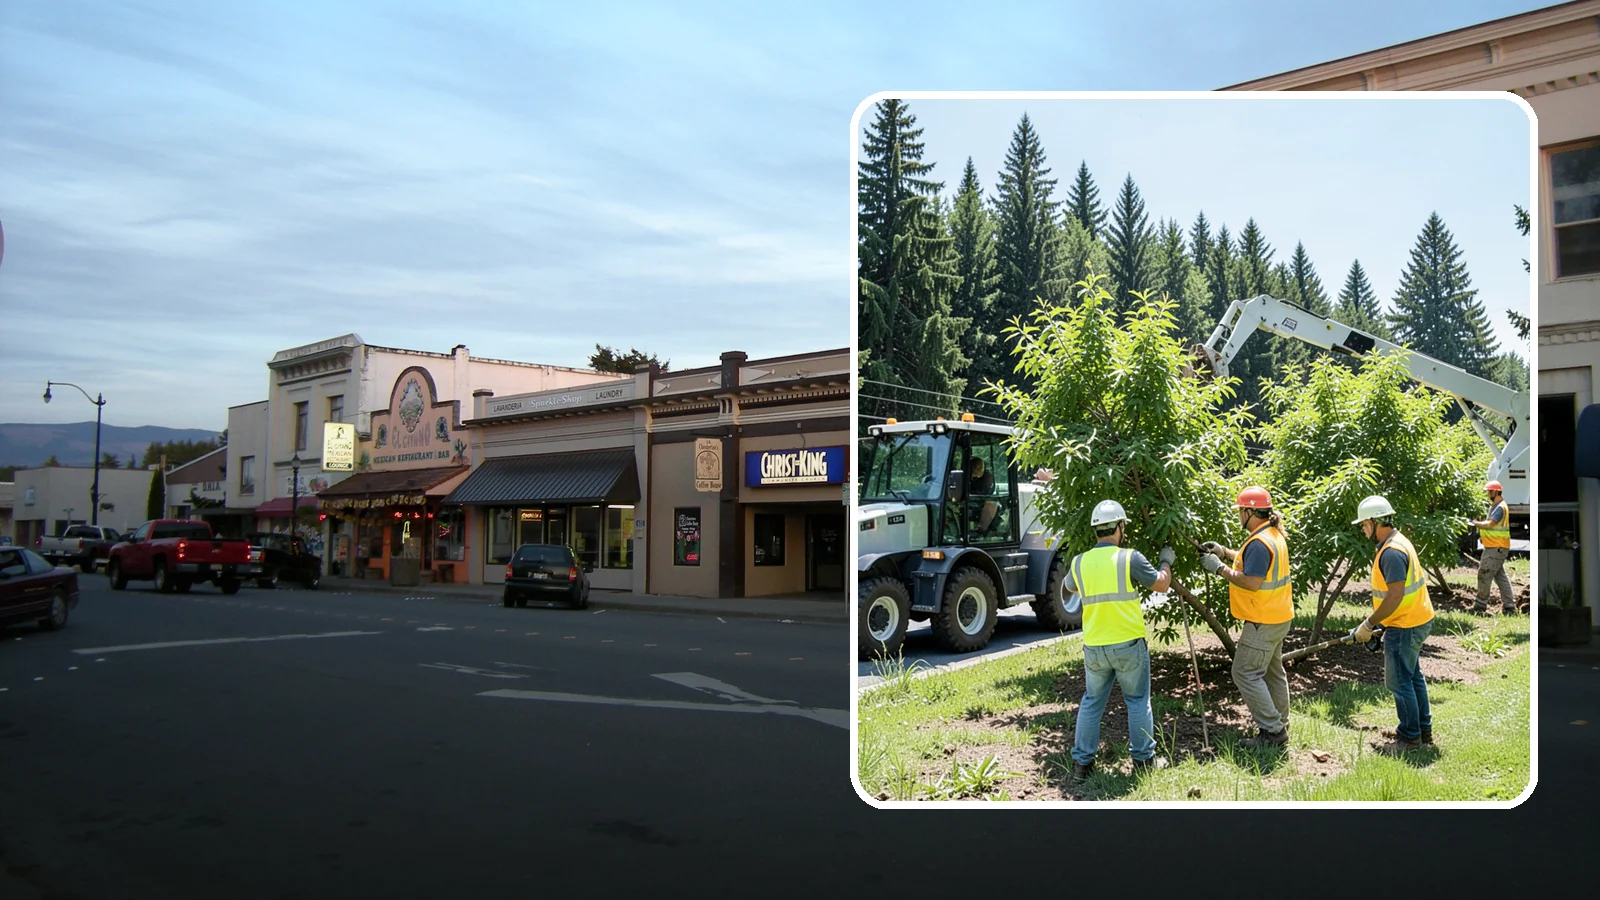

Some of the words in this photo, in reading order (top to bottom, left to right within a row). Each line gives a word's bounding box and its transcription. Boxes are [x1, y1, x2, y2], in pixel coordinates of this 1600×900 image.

[562, 394, 583, 405] Shop
[595, 388, 623, 400] LAUNDRY
[493, 401, 522, 413] LAVANDERIA
[397, 451, 433, 463] RESTAURANT
[437, 450, 450, 459] BAR
[761, 451, 797, 478] CHRIST
[799, 449, 827, 476] KING
